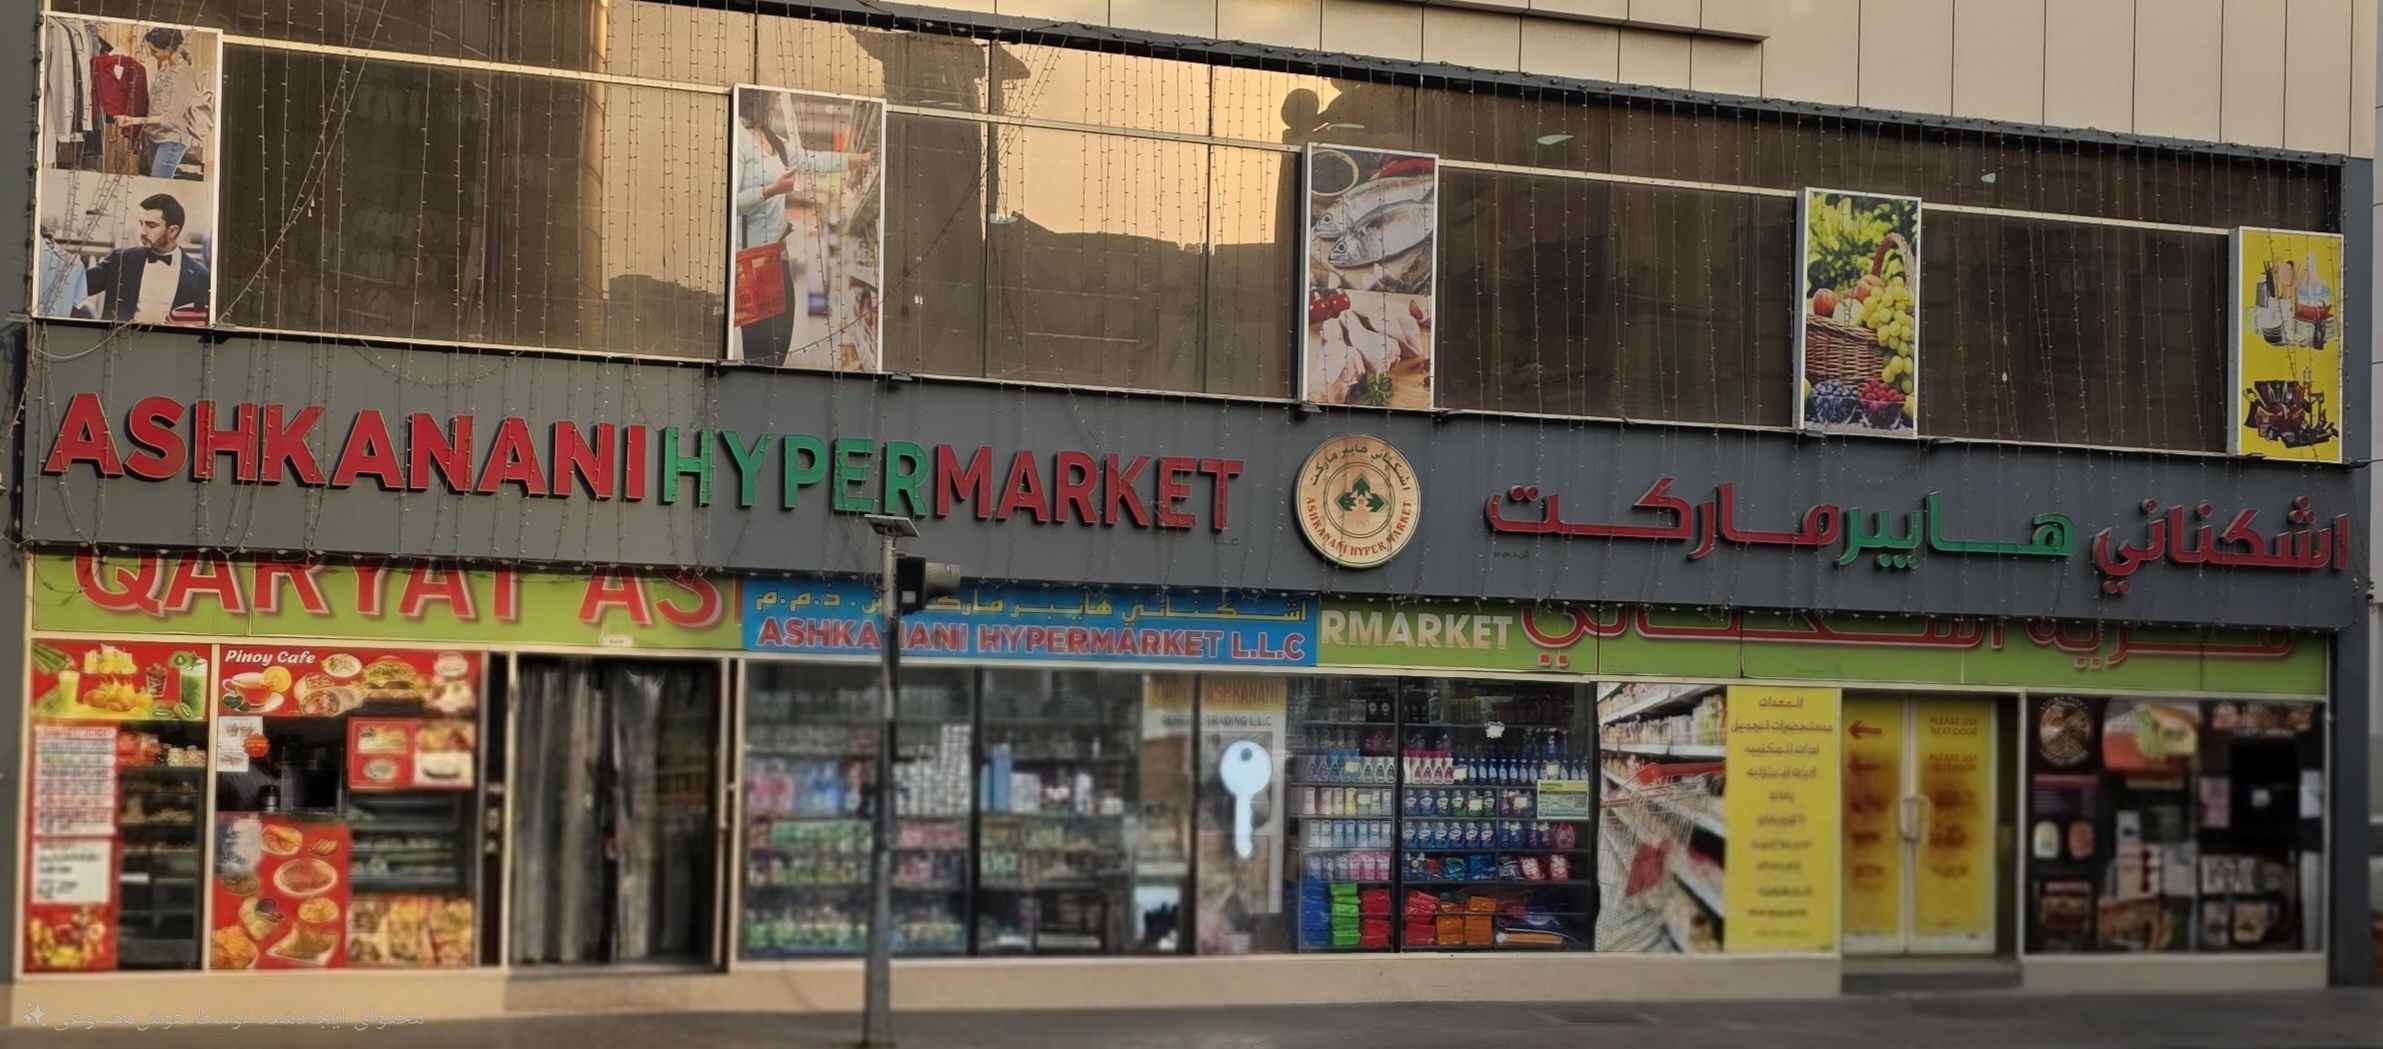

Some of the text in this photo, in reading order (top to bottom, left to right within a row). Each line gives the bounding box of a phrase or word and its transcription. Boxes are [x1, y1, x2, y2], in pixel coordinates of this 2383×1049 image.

[42, 392, 648, 502] ASHKANANI
[1306, 496, 1412, 557] ASHKANANI HYPER MARKET
[1485, 477, 2350, 593] اشكناني هايبر ماركت
[577, 566, 743, 628] AS
[1010, 592, 1113, 620] هايبر
[224, 650, 317, 666] Pinoy Cafe
[758, 617, 969, 651] ASHKAANI
[978, 624, 1224, 657] HYPERMARKET
